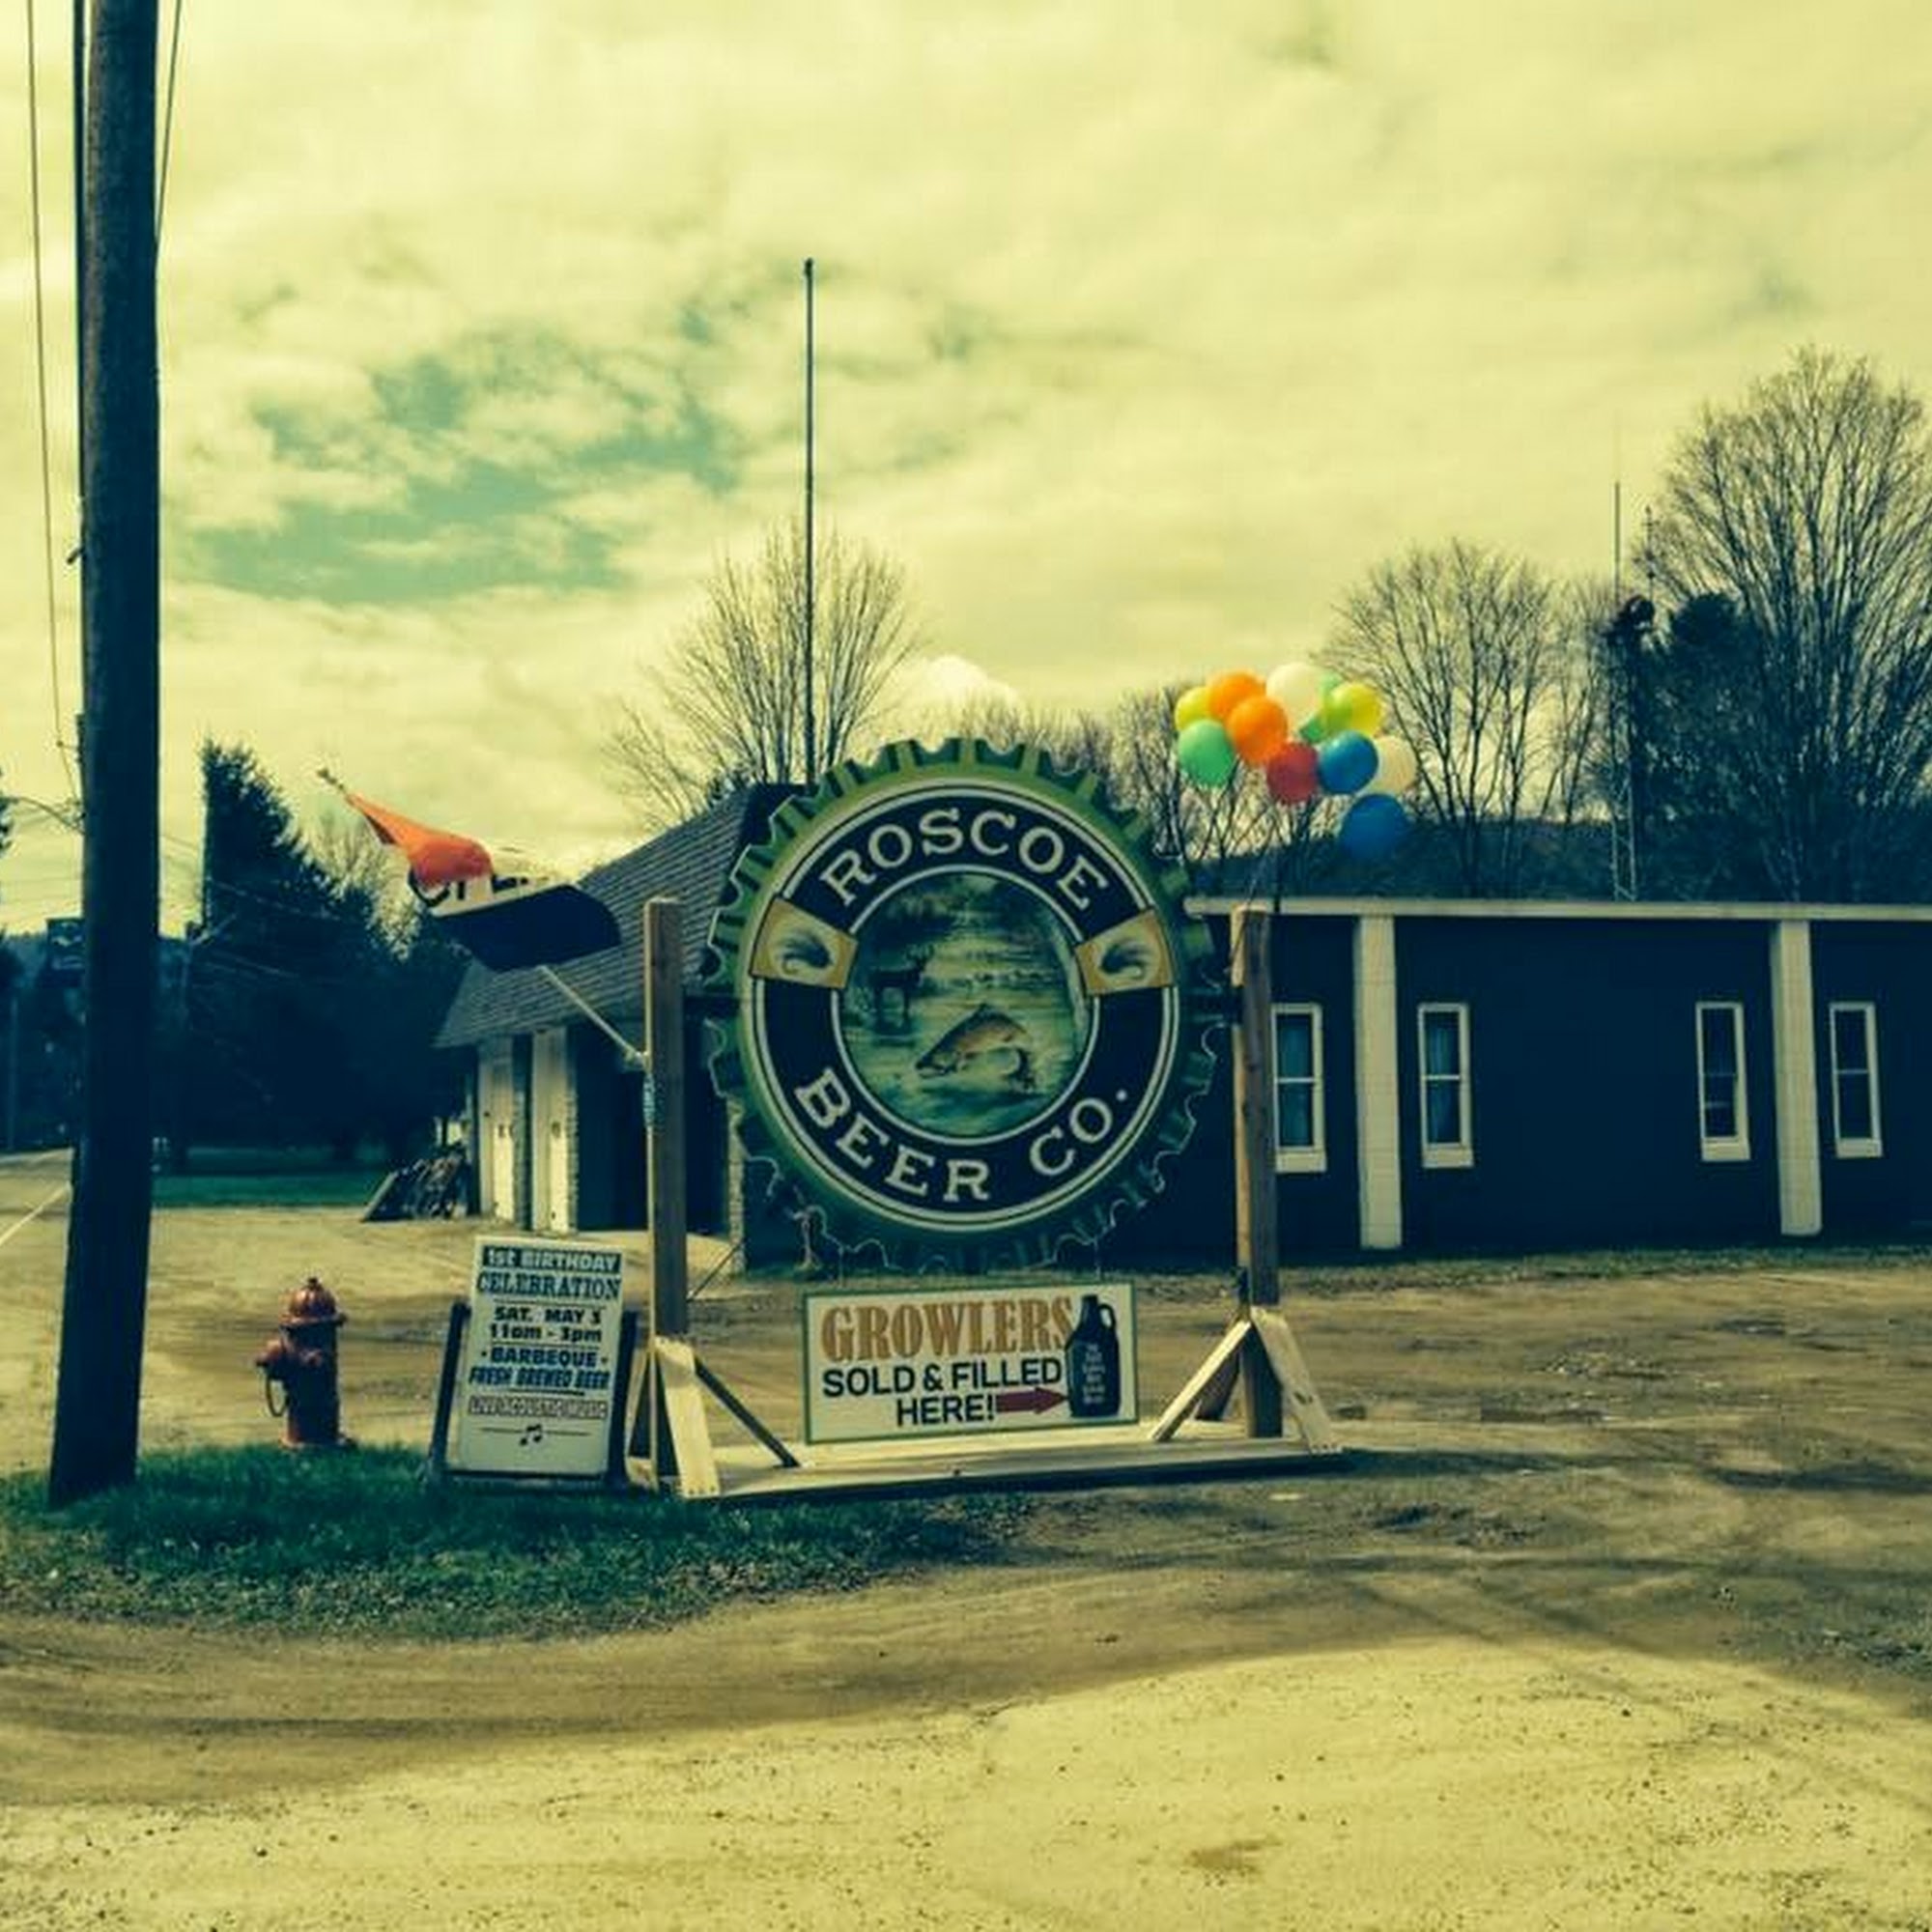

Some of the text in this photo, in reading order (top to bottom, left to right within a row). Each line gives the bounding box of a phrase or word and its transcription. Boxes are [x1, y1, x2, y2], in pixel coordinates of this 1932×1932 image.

[820, 808, 1108, 911] ROSCOE
[794, 1067, 1128, 1202] BEER CO.
[487, 1248, 616, 1271] 1st BIRTHDAY
[477, 1272, 621, 1299] CELEBRATION
[495, 1307, 533, 1321] SAT.
[545, 1309, 583, 1322] MAY
[821, 1296, 1072, 1362] GROWLERS
[492, 1349, 597, 1368] BARBEQUE
[823, 1366, 915, 1397] SOLD
[923, 1364, 944, 1392] &
[952, 1358, 1063, 1389] FILLED
[896, 1395, 995, 1427] HERE!
